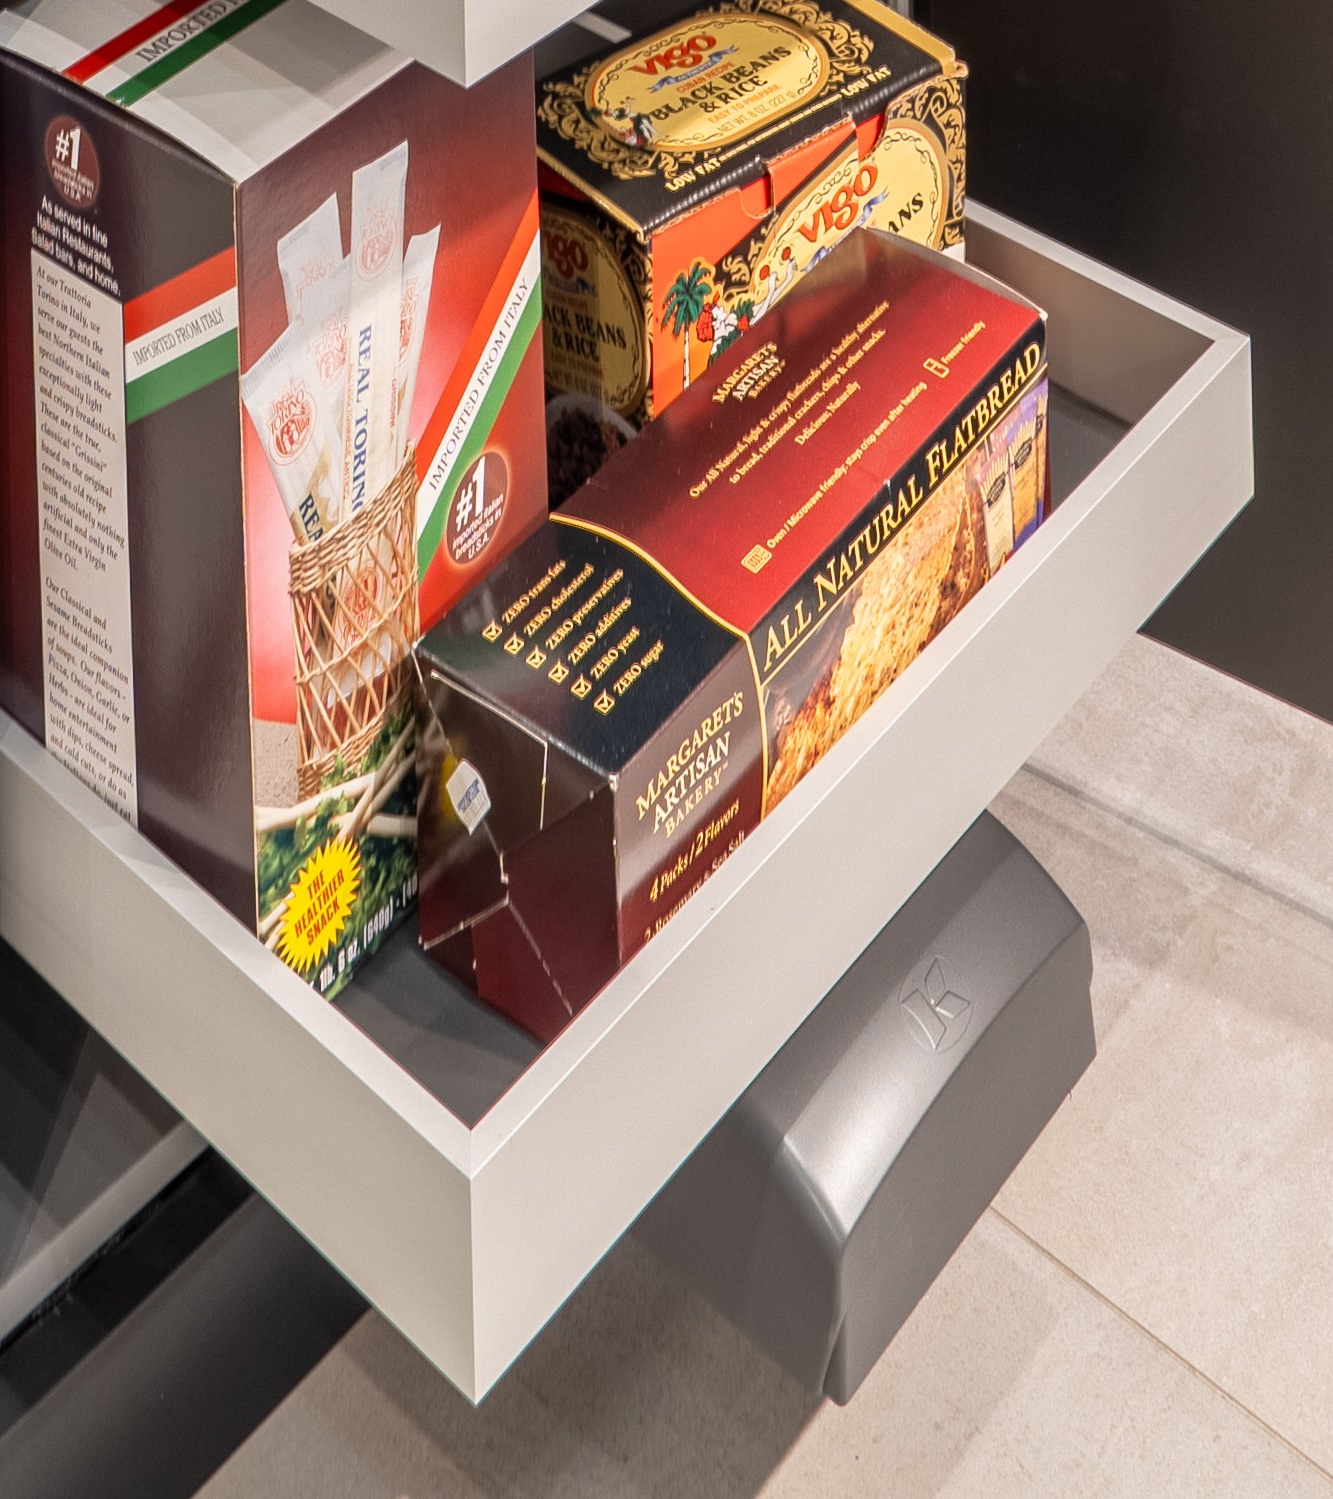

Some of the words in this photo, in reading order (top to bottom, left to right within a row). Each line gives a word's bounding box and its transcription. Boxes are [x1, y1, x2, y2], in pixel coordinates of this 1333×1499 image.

[652, 82, 721, 122] BLACK
[721, 45, 791, 85] BEANS
[698, 98, 721, 114] &
[719, 75, 769, 107] RICE
[841, 78, 868, 98] LOW
[55, 125, 81, 172] #1
[664, 170, 698, 192] LOW
[133, 330, 176, 366] IMPORTED
[177, 321, 200, 344] FROM
[200, 307, 225, 332] ITALY
[563, 332, 600, 362] RICE
[939, 339, 965, 366] Freezer
[960, 320, 986, 345] friendly
[429, 389, 479, 491] IMPORTED
[478, 331, 505, 388] FROM
[504, 277, 529, 329] ITALY
[712, 341, 778, 404] MARGARET'S
[732, 354, 780, 402] ARTISAN
[748, 364, 783, 400] BAKERY
[456, 456, 486, 532] #1
[764, 599, 813, 672] ALL
[814, 474, 926, 613] NATURAL
[925, 342, 1042, 490] FLATBREAD
[502, 593, 530, 625] ZERO
[528, 575, 552, 599] trans
[524, 605, 552, 638] ZERO
[551, 562, 595, 612] cholesterol
[545, 618, 574, 651] ZERO
[572, 568, 624, 626] preservatives
[568, 631, 596, 666] ZERO
[595, 596, 632, 639] additives
[590, 646, 619, 681] ZERO
[617, 625, 641, 656] yeast
[613, 661, 642, 697] ZERO
[640, 639, 665, 669] sugar
[635, 691, 744, 821] MARGARET'S
[652, 730, 731, 834] ARTISAN
[664, 769, 723, 839] BAKERY
[649, 876, 658, 903] 4
[659, 850, 689, 895] Packs
[696, 830, 704, 857] 2
[704, 796, 741, 847] Flavors
[295, 869, 345, 938] HEALTHIER
[307, 871, 325, 899] THE
[306, 897, 340, 945] SNACK
